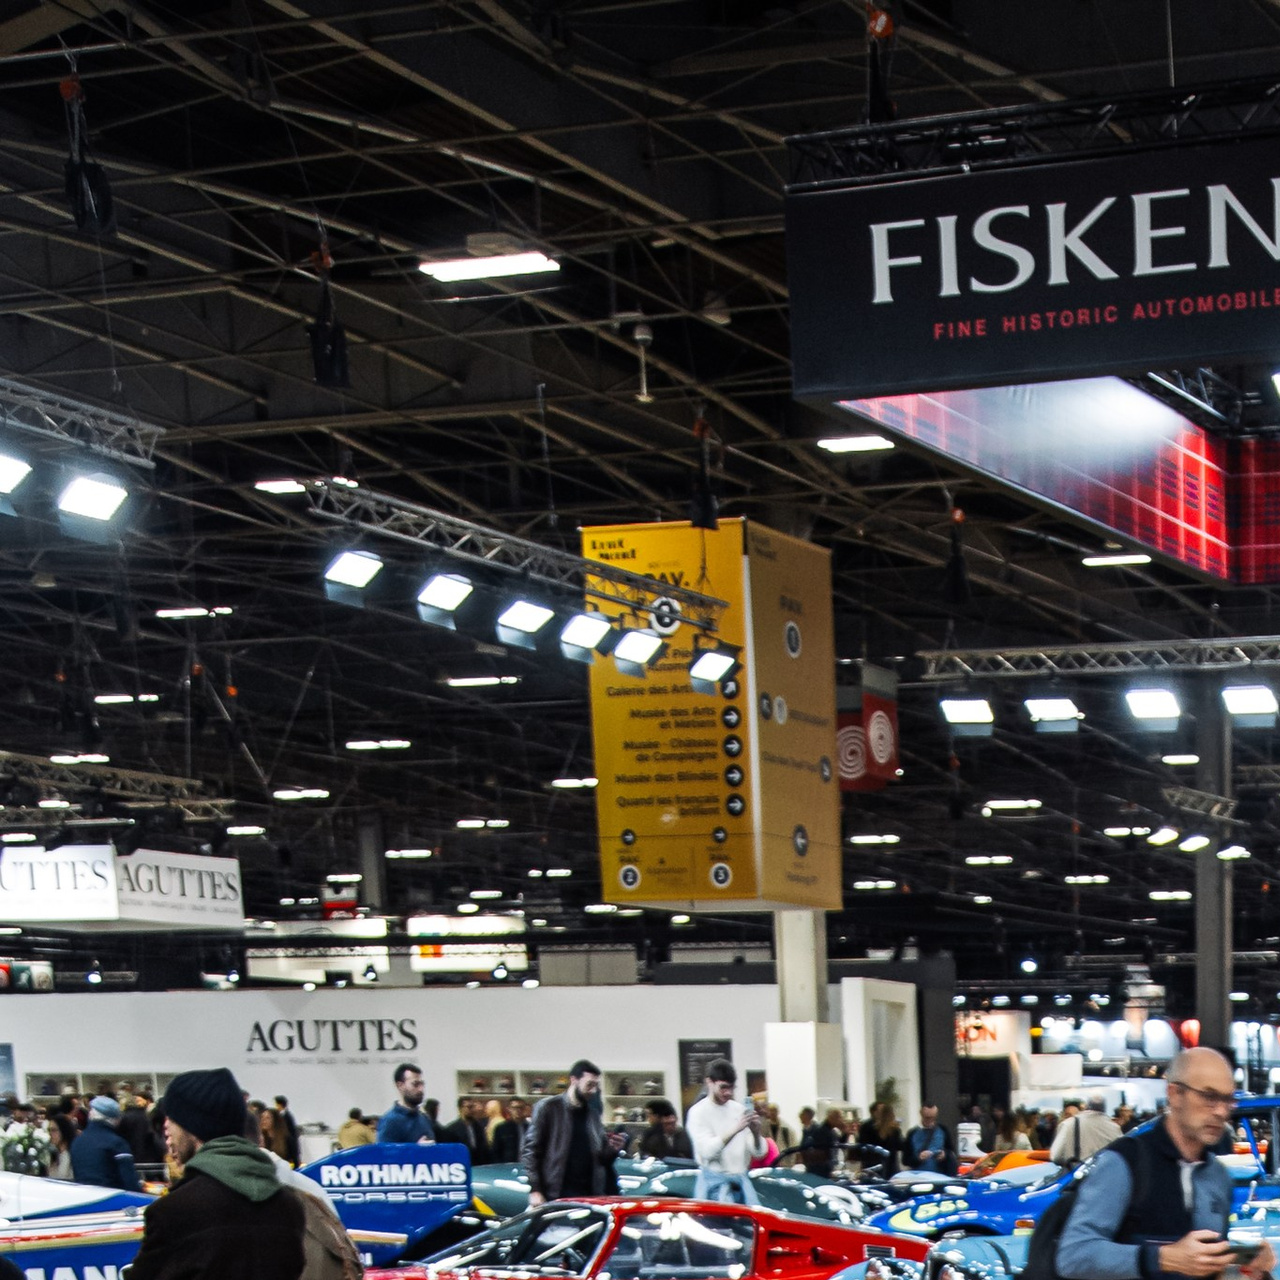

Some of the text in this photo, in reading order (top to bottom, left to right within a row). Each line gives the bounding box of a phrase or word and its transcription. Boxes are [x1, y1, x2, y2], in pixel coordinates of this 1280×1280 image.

[934, 320, 987, 340] FINE
[1003, 306, 1118, 334] HISTORIC
[118, 862, 239, 901] AGUTTES
[246, 1018, 418, 1052] AGUTTES
[320, 1163, 468, 1187] ROTHMANS
